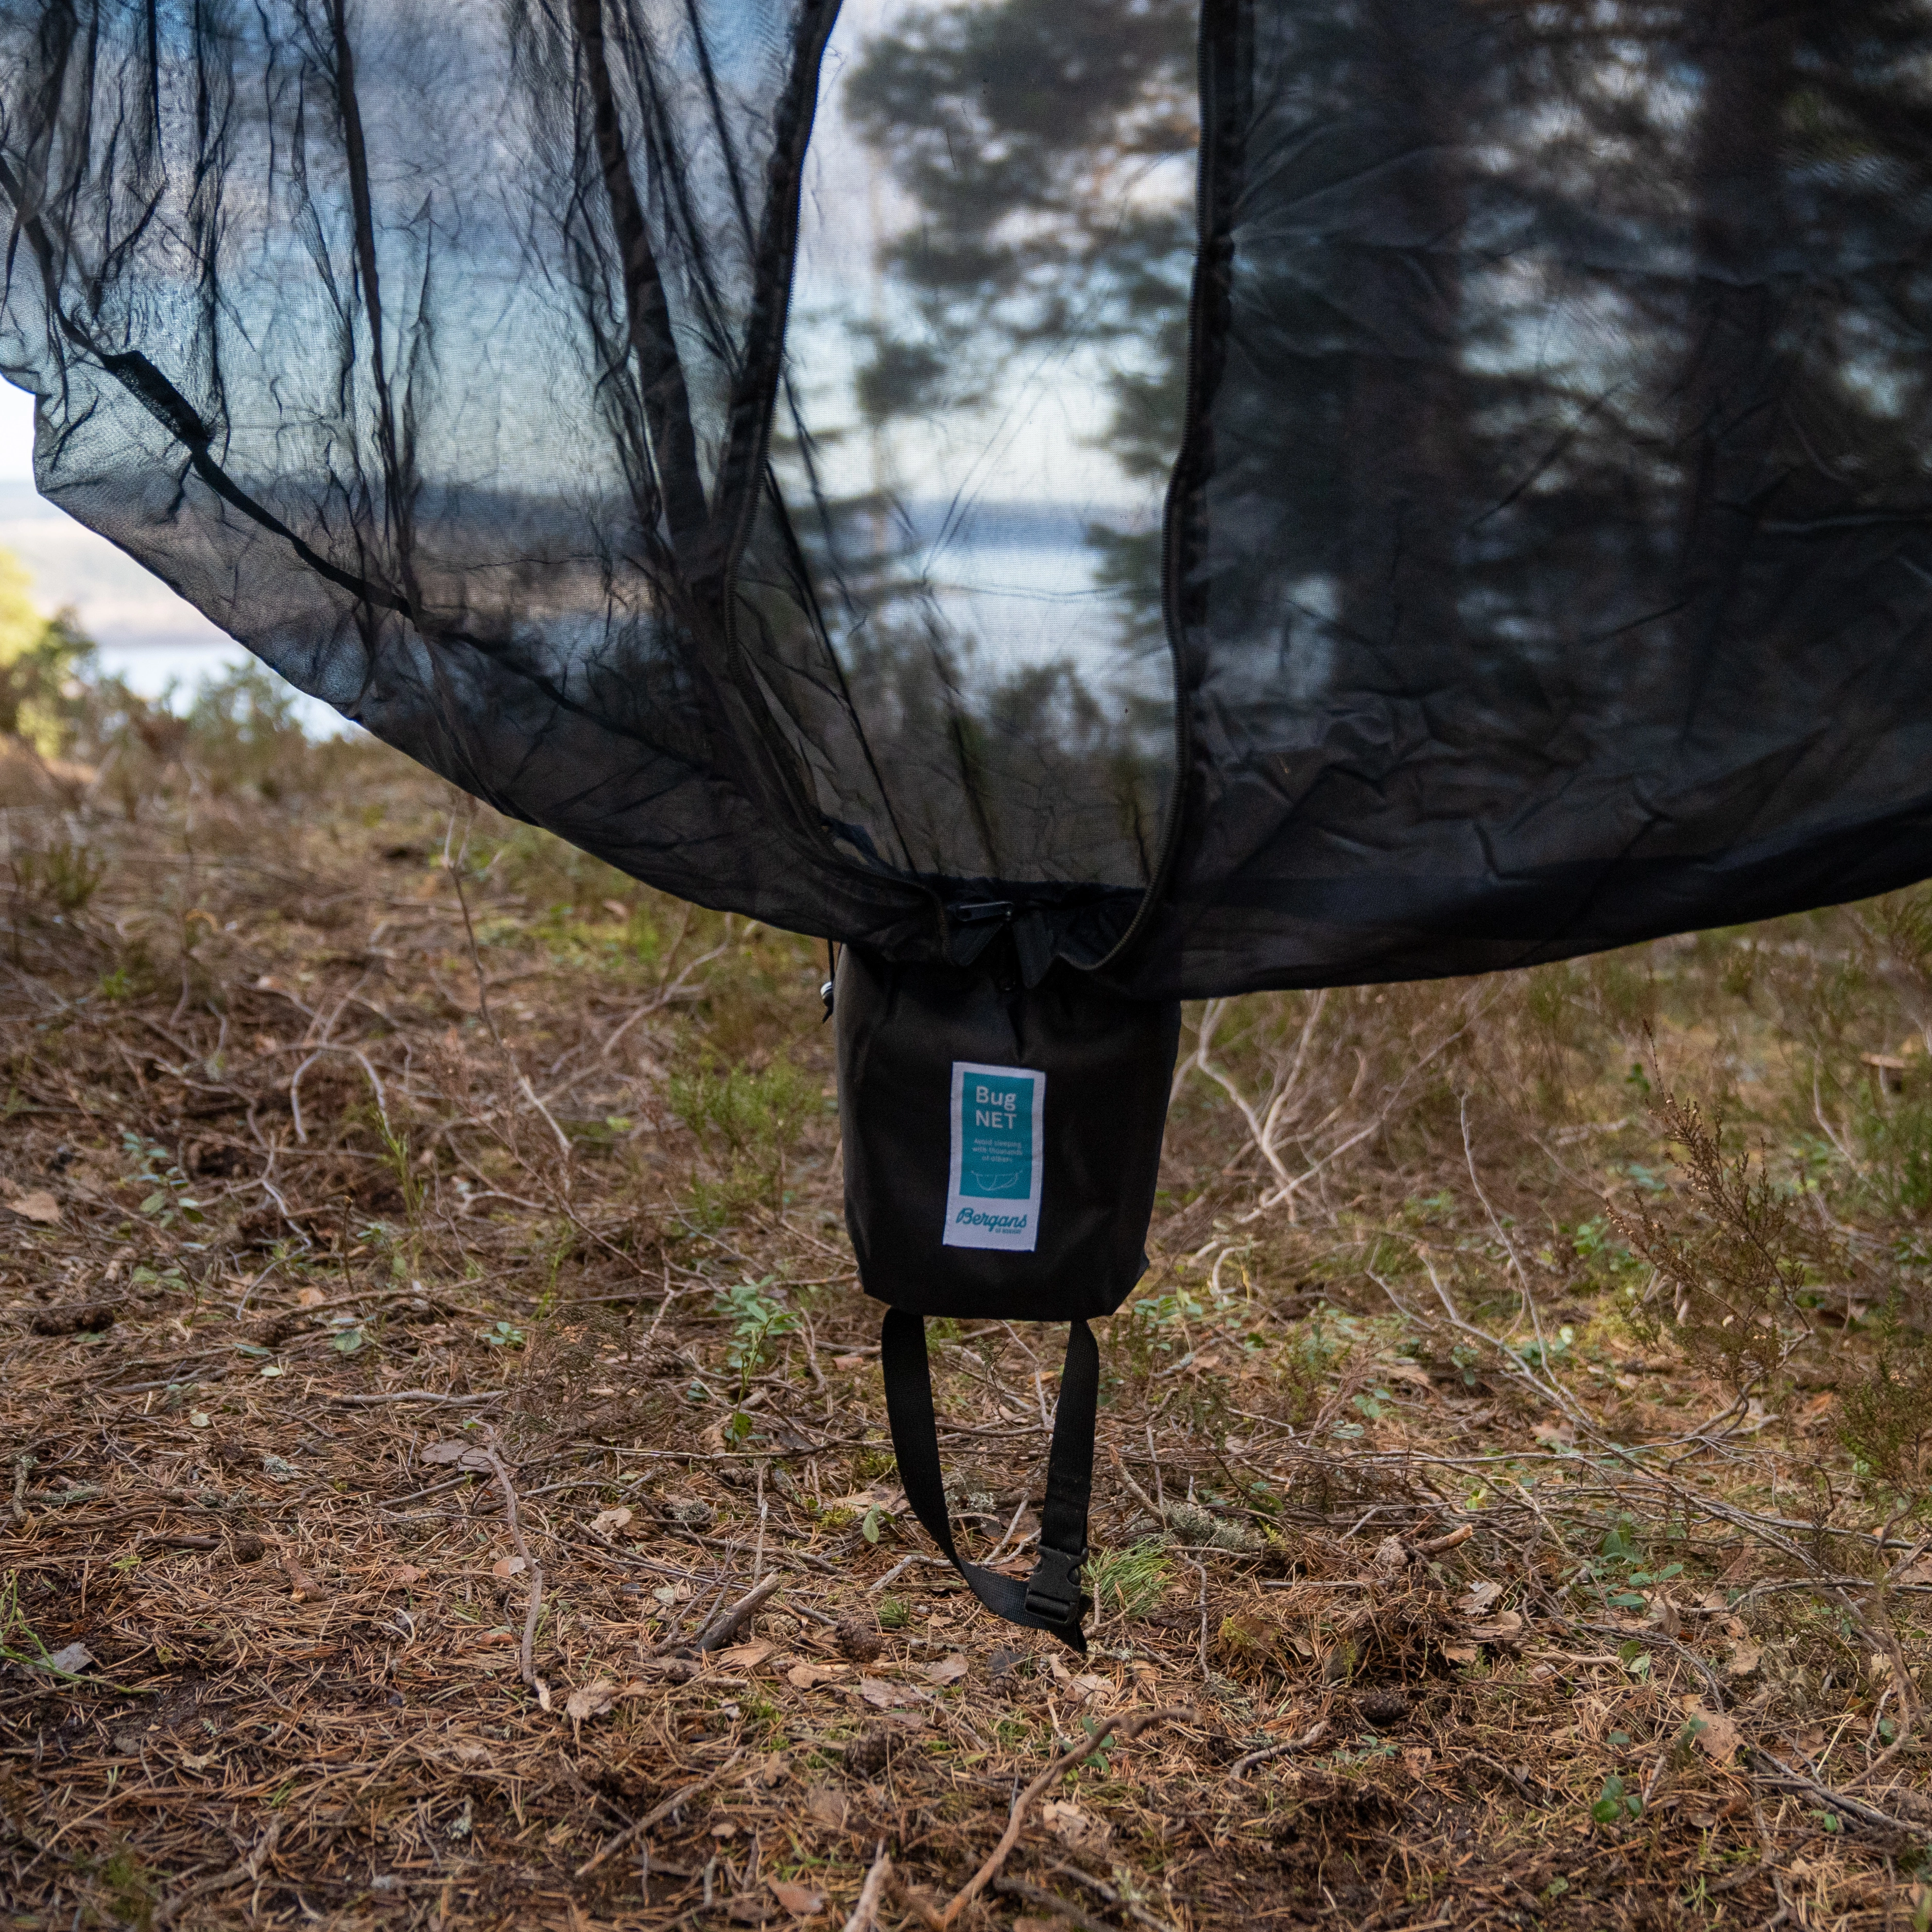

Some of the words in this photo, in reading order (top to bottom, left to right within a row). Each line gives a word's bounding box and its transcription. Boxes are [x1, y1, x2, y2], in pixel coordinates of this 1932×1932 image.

[976, 1085, 1016, 1111] Bug
[976, 1110, 1017, 1129] NET
[955, 1207, 1027, 1232] Bergans
